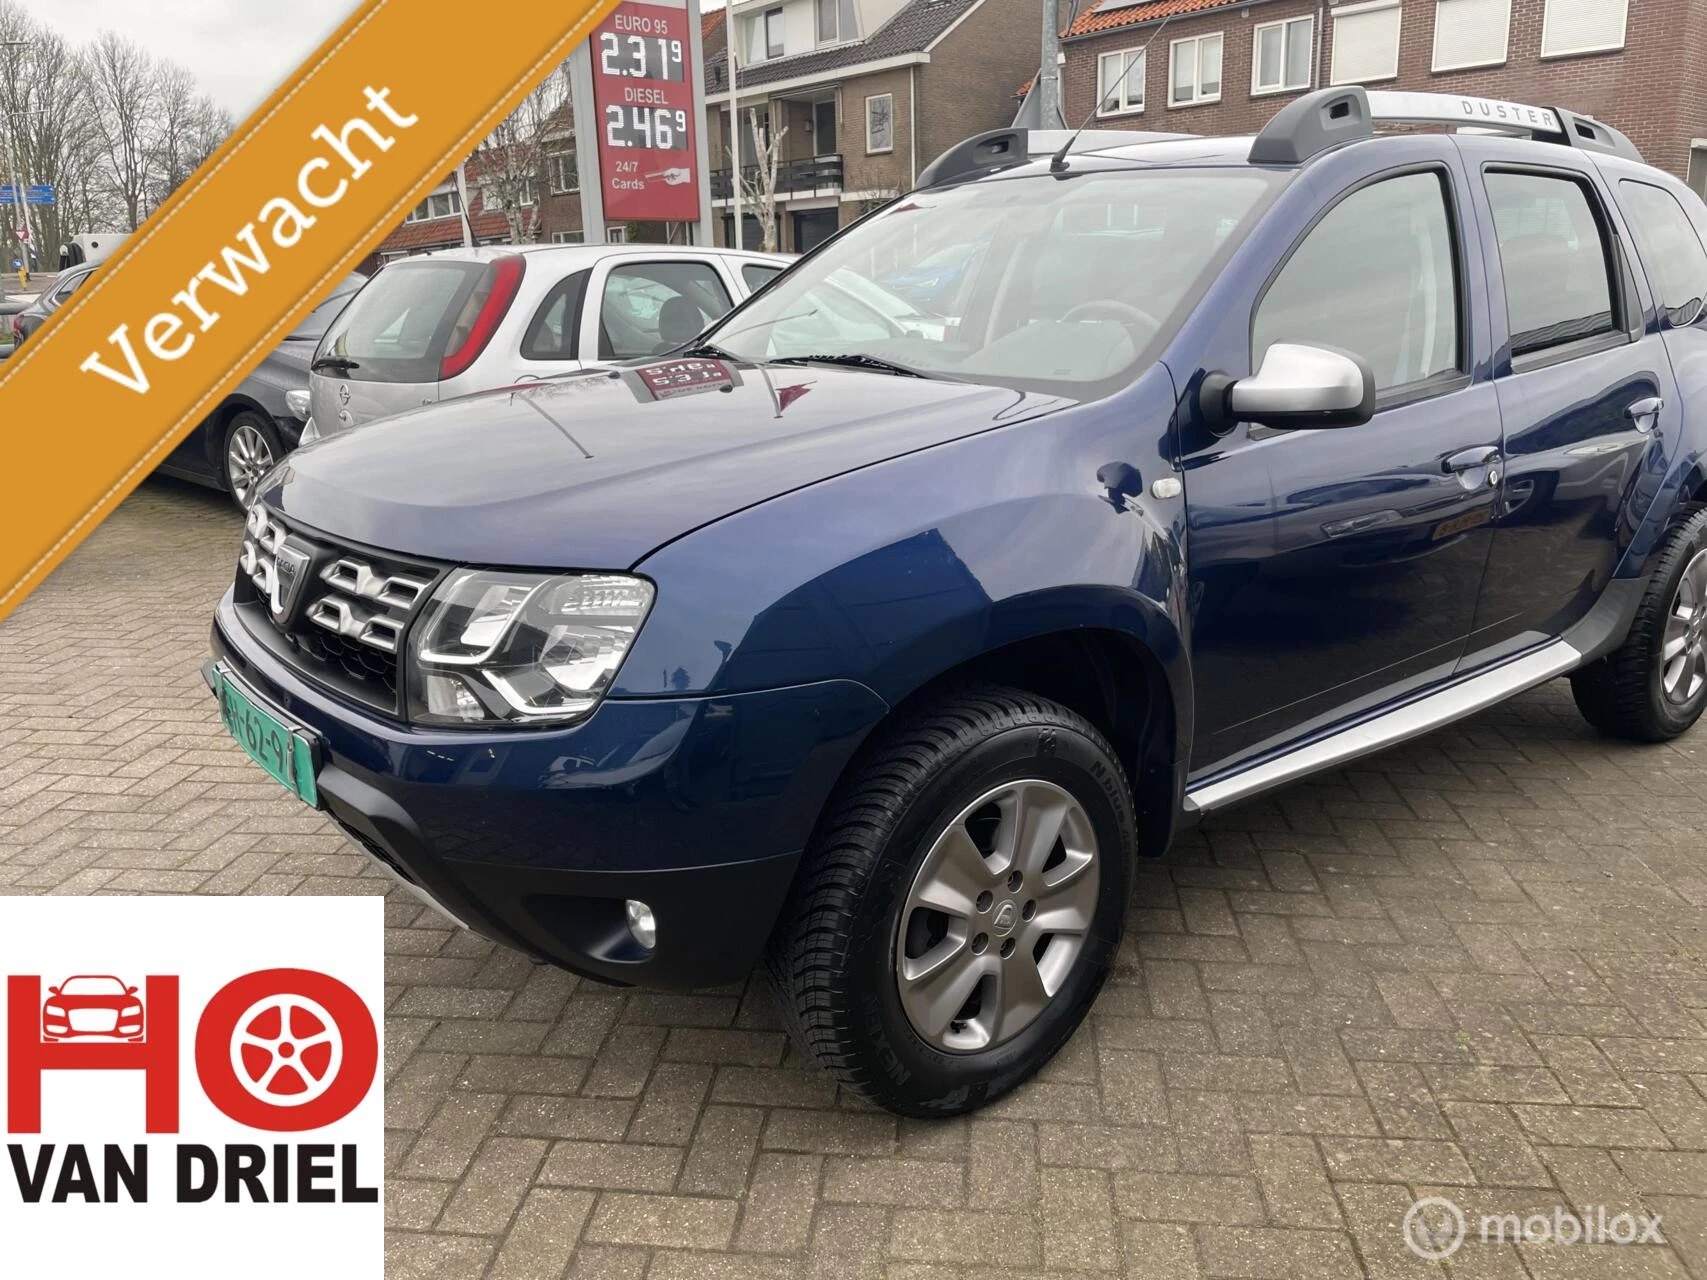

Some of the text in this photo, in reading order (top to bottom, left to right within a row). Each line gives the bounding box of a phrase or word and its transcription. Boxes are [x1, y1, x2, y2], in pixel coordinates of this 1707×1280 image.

[614, 14, 668, 35] EURO 95
[624, 86, 669, 105] DIESEL
[1463, 100, 1553, 126] DUSTER
[615, 160, 638, 173] 24/7
[611, 178, 645, 190] Cards
